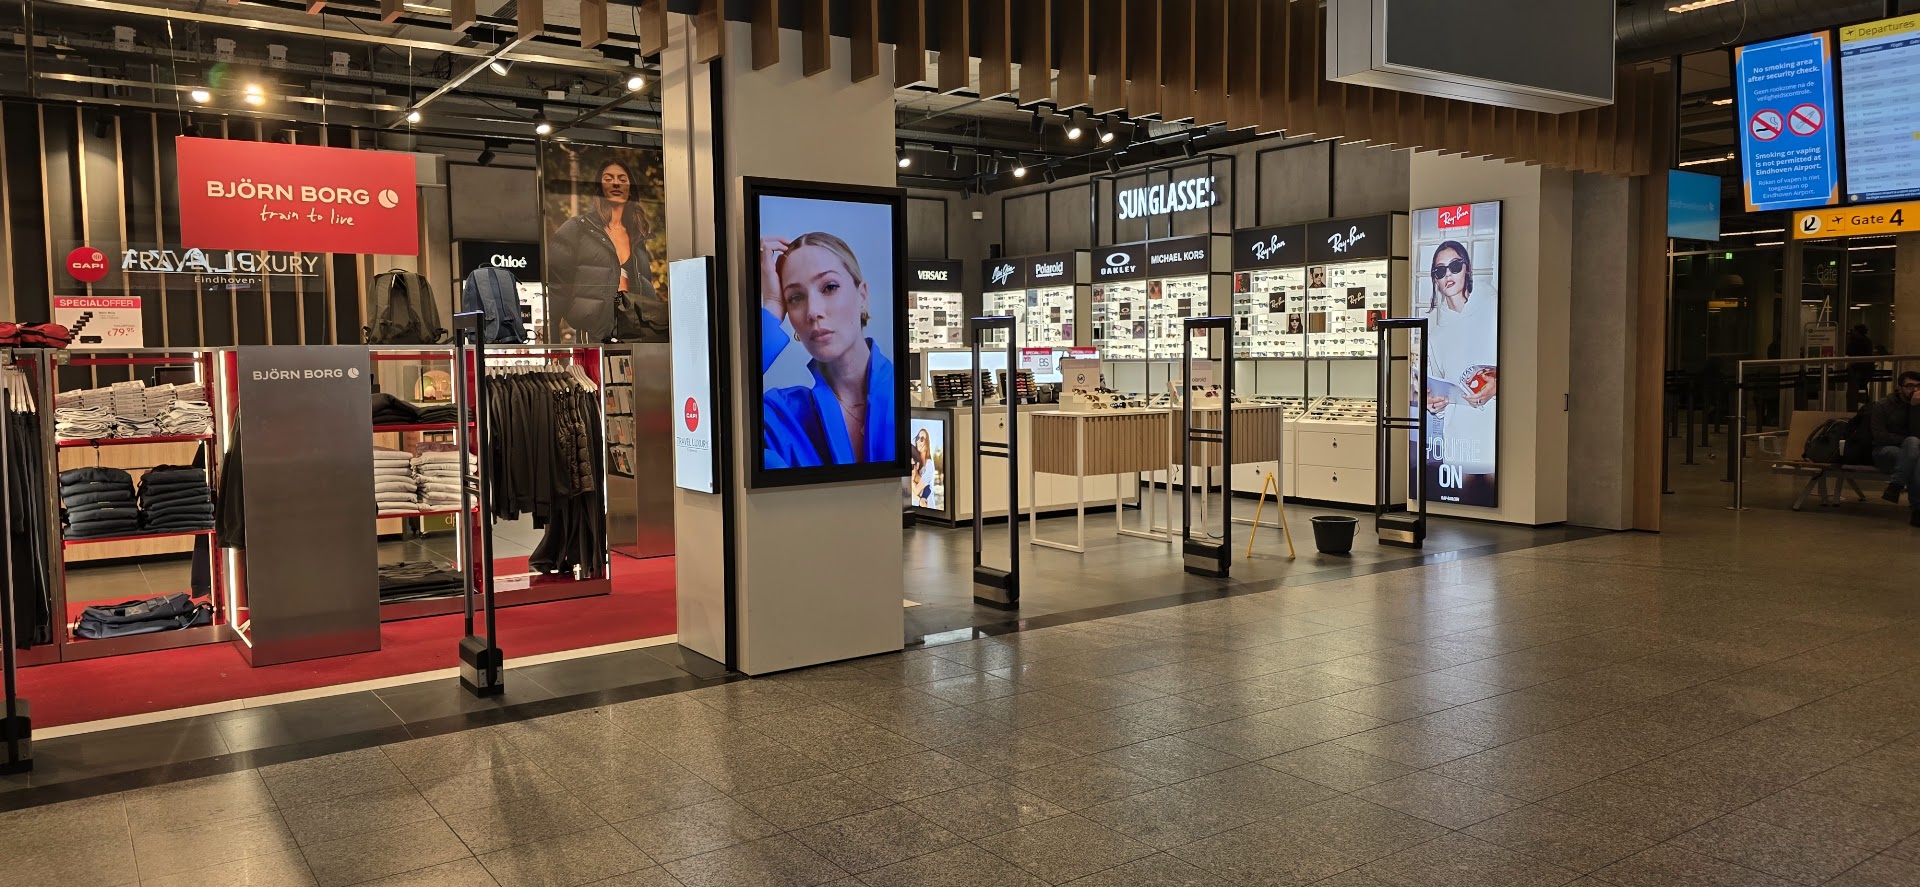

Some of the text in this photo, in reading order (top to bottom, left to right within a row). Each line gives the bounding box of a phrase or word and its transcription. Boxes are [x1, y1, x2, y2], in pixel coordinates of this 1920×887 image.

[1858, 20, 1915, 37] Departures
[1765, 62, 1795, 72] smoking
[1796, 58, 1813, 66] area
[1747, 66, 1820, 83] after security check.
[1770, 84, 1797, 92] rookzone
[1755, 151, 1786, 160] Smoking
[1796, 147, 1821, 155] vaping
[1776, 155, 1812, 166] permitted
[1756, 163, 1822, 176] Eindhoven Airport.
[206, 178, 370, 205] BJÖRN BORG
[1118, 176, 1216, 220] SUNGLASSES
[260, 204, 355, 226] train to live
[1851, 208, 1904, 227] Gate 4
[122, 251, 319, 273] TRAVEL LUXURY
[490, 254, 528, 268] Chloé
[1150, 250, 1205, 264] MICHAEL KORS
[1035, 261, 1064, 274] Polaroid
[1100, 265, 1137, 275] OAKLEY
[1816, 263, 1838, 281] Gate
[194, 276, 255, 284] Eindhoven
[917, 270, 948, 281] VERSACE
[252, 368, 343, 380] BJÖRN BORG
[1426, 436, 1481, 463] YOU'RE
[1438, 464, 1463, 489] ON
